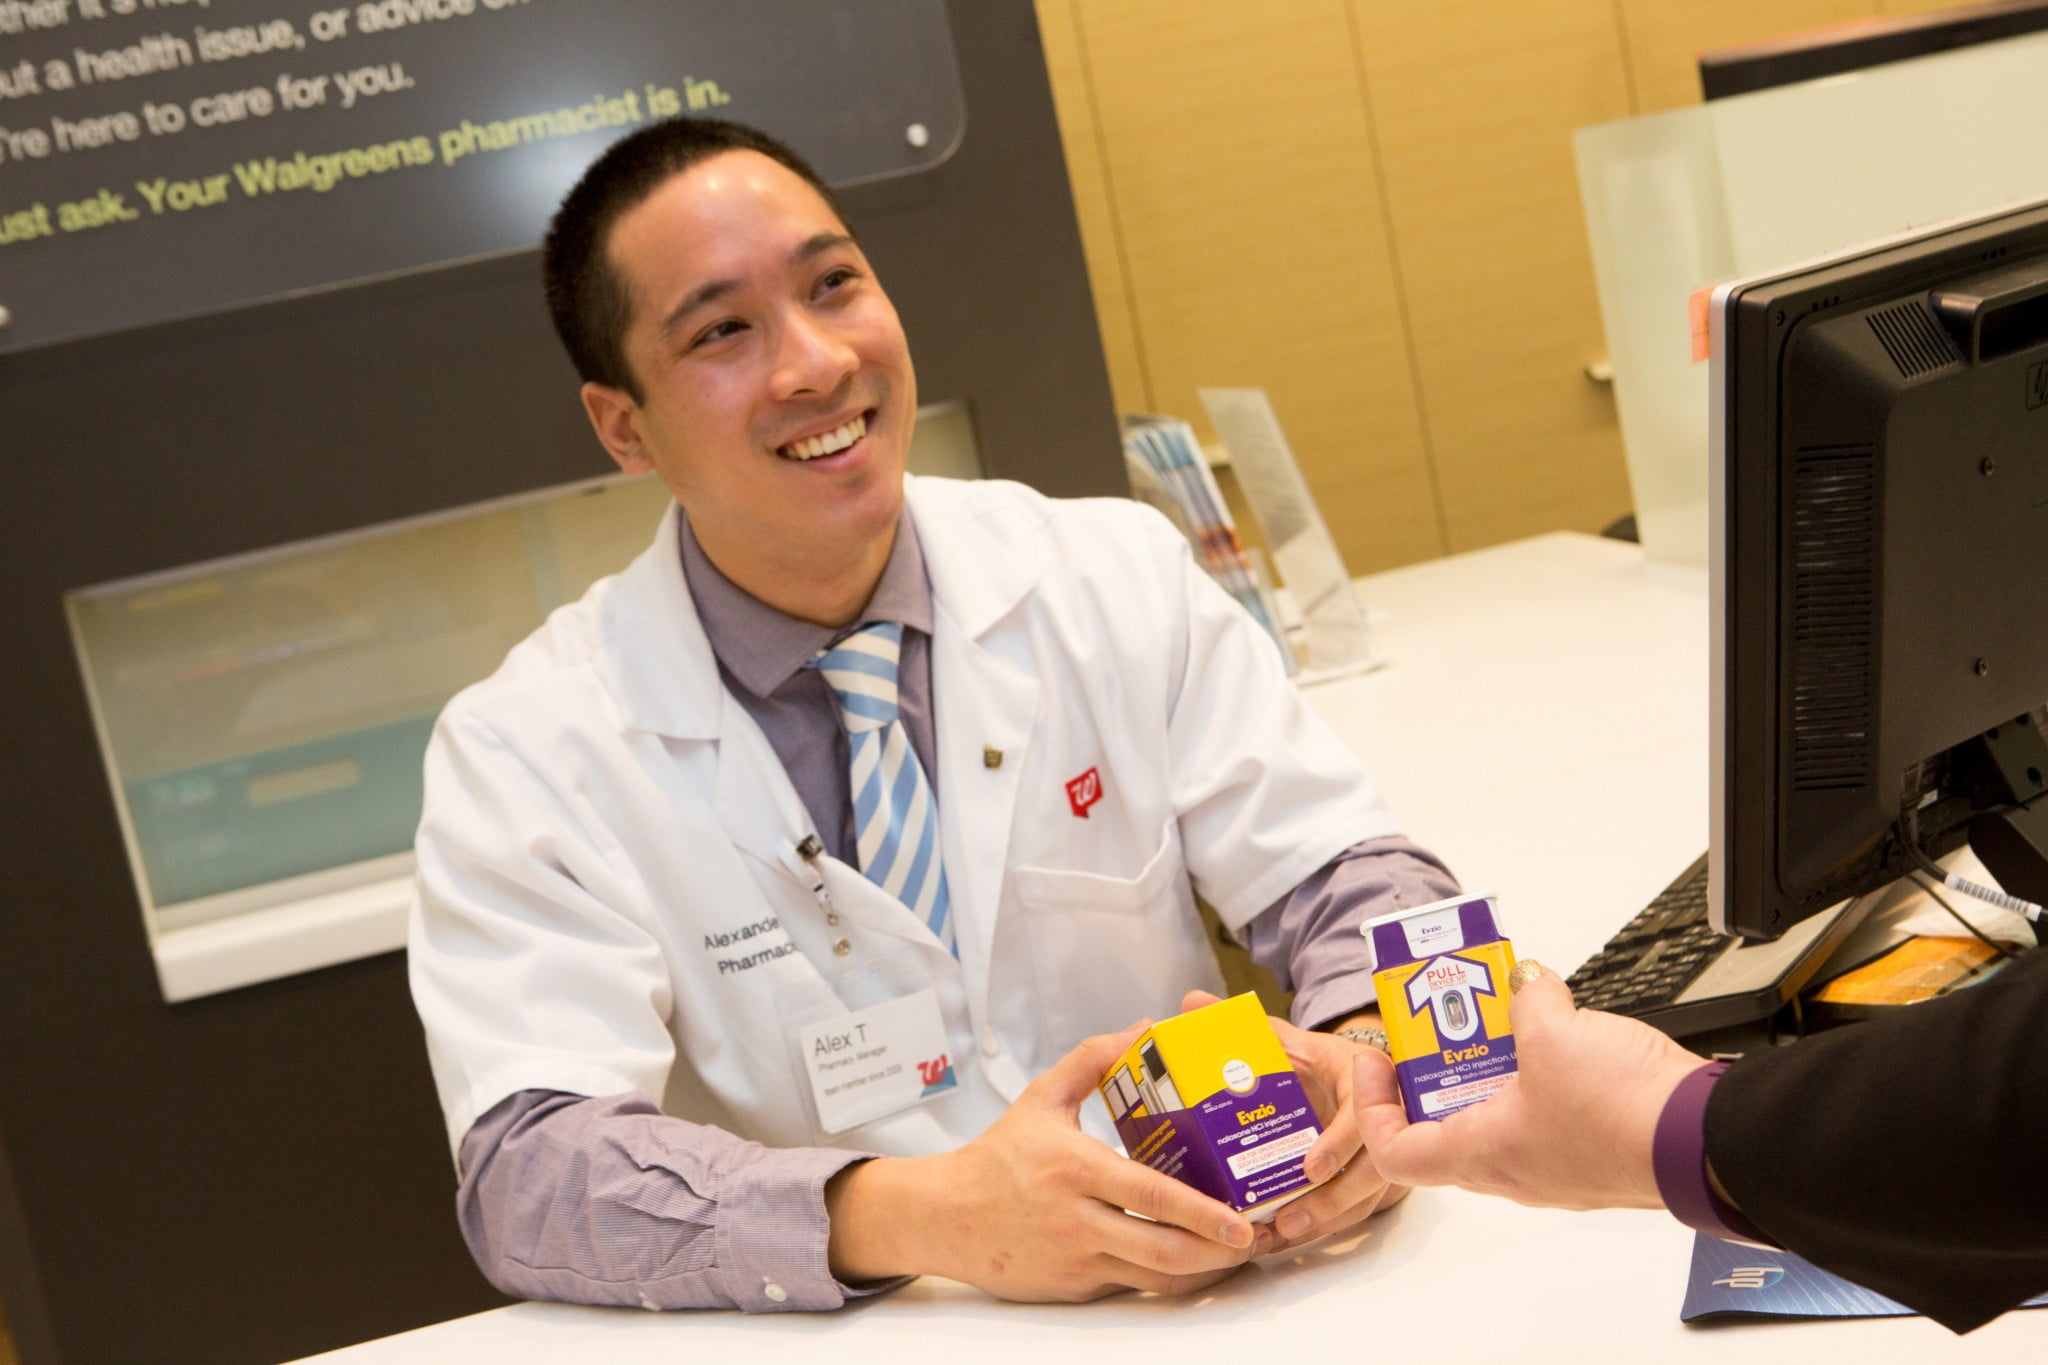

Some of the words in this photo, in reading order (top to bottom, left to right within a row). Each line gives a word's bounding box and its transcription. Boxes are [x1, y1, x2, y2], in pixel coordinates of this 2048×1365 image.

[44, 59, 76, 91] a
[74, 33, 194, 85] health
[194, 18, 306, 63] issue,
[309, 8, 351, 42] or
[52, 116, 141, 152] here
[142, 101, 187, 136] to
[190, 86, 275, 127] care
[276, 73, 329, 111] for
[333, 61, 416, 109] you.
[57, 187, 140, 233] ask.
[134, 177, 230, 215] Your
[232, 136, 435, 197] Walgreens
[438, 89, 643, 167] pharmacist
[644, 82, 681, 117] is
[682, 75, 731, 112] in.
[1421, 925, 1442, 935] Evzio
[1426, 964, 1465, 981] PULL
[1430, 976, 1456, 988] DEVICE
[1456, 973, 1467, 981] UP
[814, 1033, 852, 1057] Alex
[855, 1023, 867, 1043] T
[1442, 1043, 1489, 1065] Evzio
[1414, 1068, 1455, 1083] naloxone
[1236, 1104, 1276, 1126] Evzio
[1217, 1128, 1251, 1145] naloxone
